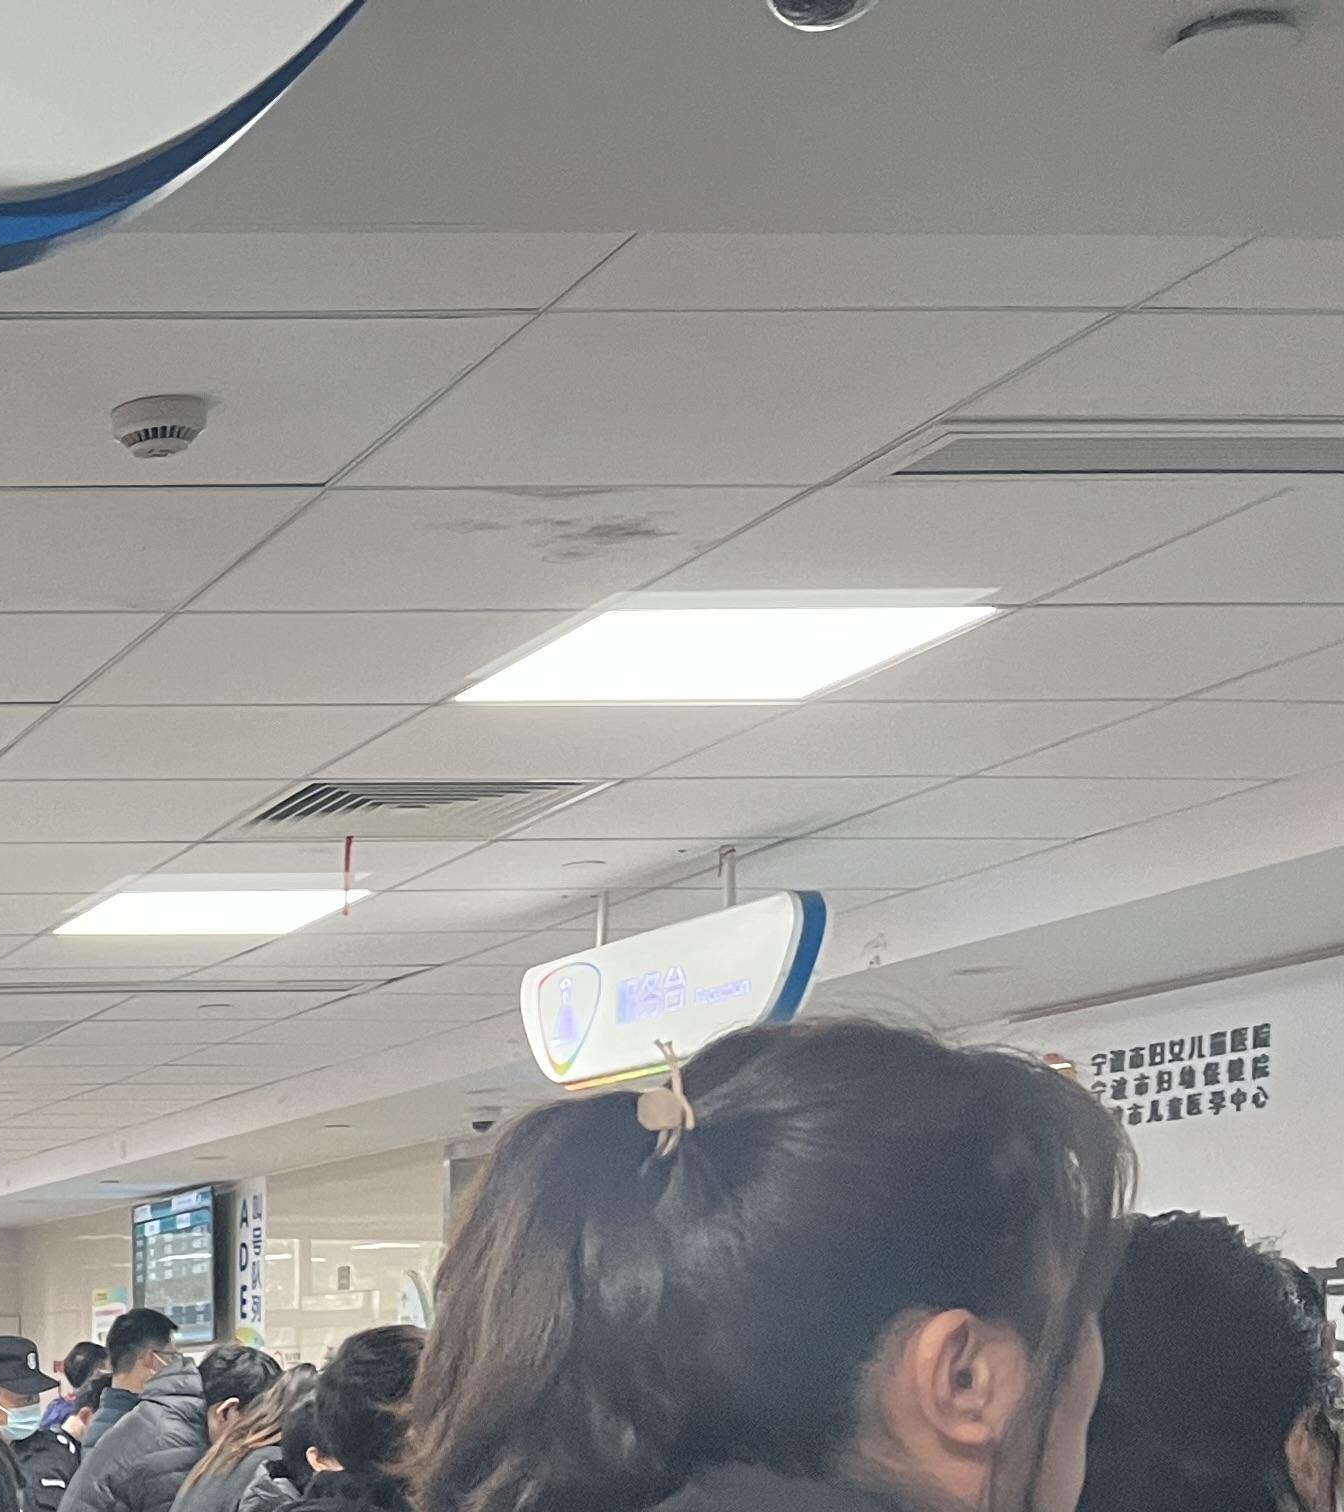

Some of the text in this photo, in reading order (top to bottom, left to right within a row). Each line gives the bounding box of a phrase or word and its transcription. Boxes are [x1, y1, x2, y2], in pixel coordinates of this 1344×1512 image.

[1090, 1022, 1272, 1077] 宁波市妇女儿童医院
